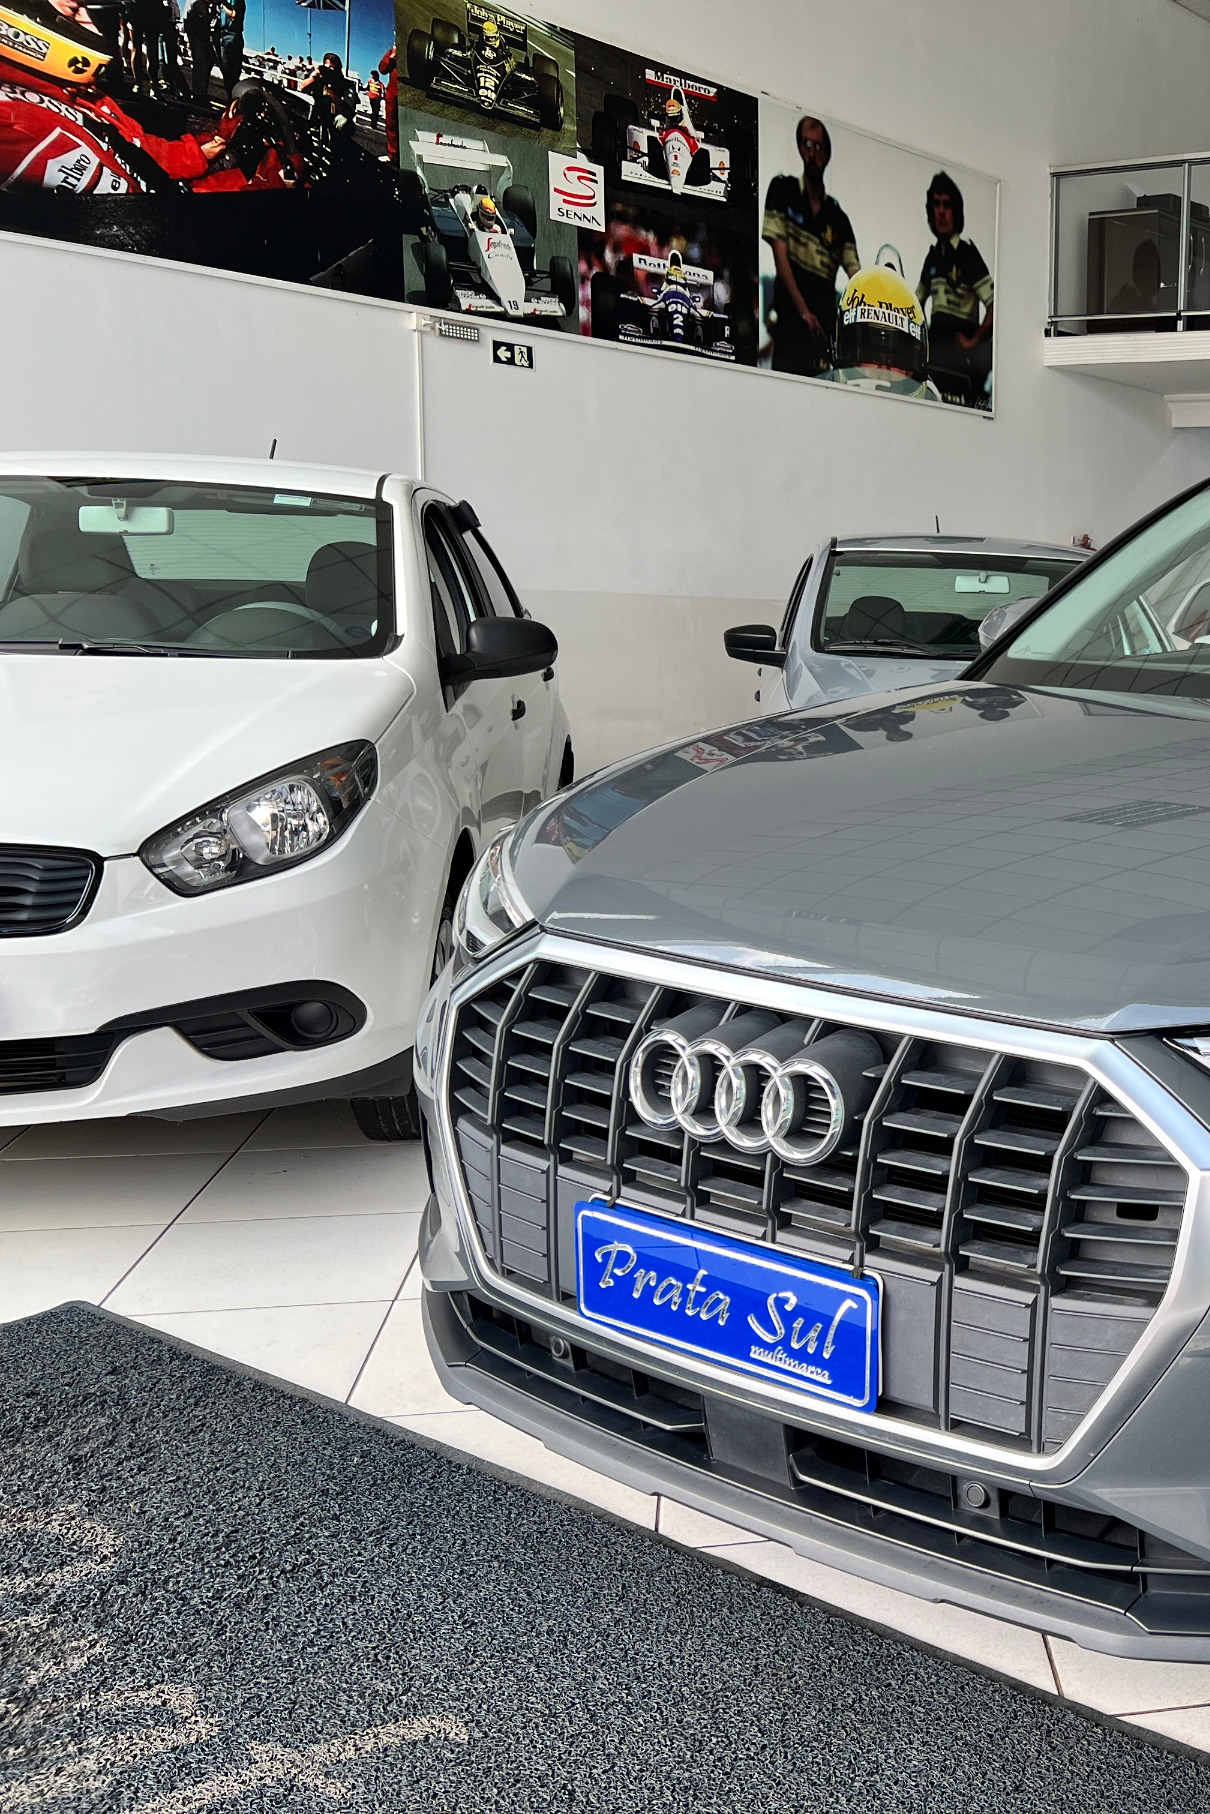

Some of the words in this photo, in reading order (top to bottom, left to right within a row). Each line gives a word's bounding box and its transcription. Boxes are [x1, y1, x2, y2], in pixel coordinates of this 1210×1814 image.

[480, 77, 495, 92] 12
[655, 71, 711, 95] Marlboro
[557, 207, 601, 227] SENNA
[638, 257, 709, 281] Rothans
[507, 299, 519, 311] 19
[672, 313, 684, 326] 2
[843, 307, 856, 326] elf
[859, 307, 906, 329] RENAULT
[594, 1240, 731, 1326] Prata
[747, 1291, 858, 1360] Sul
[750, 1345, 832, 1383] multimarca
